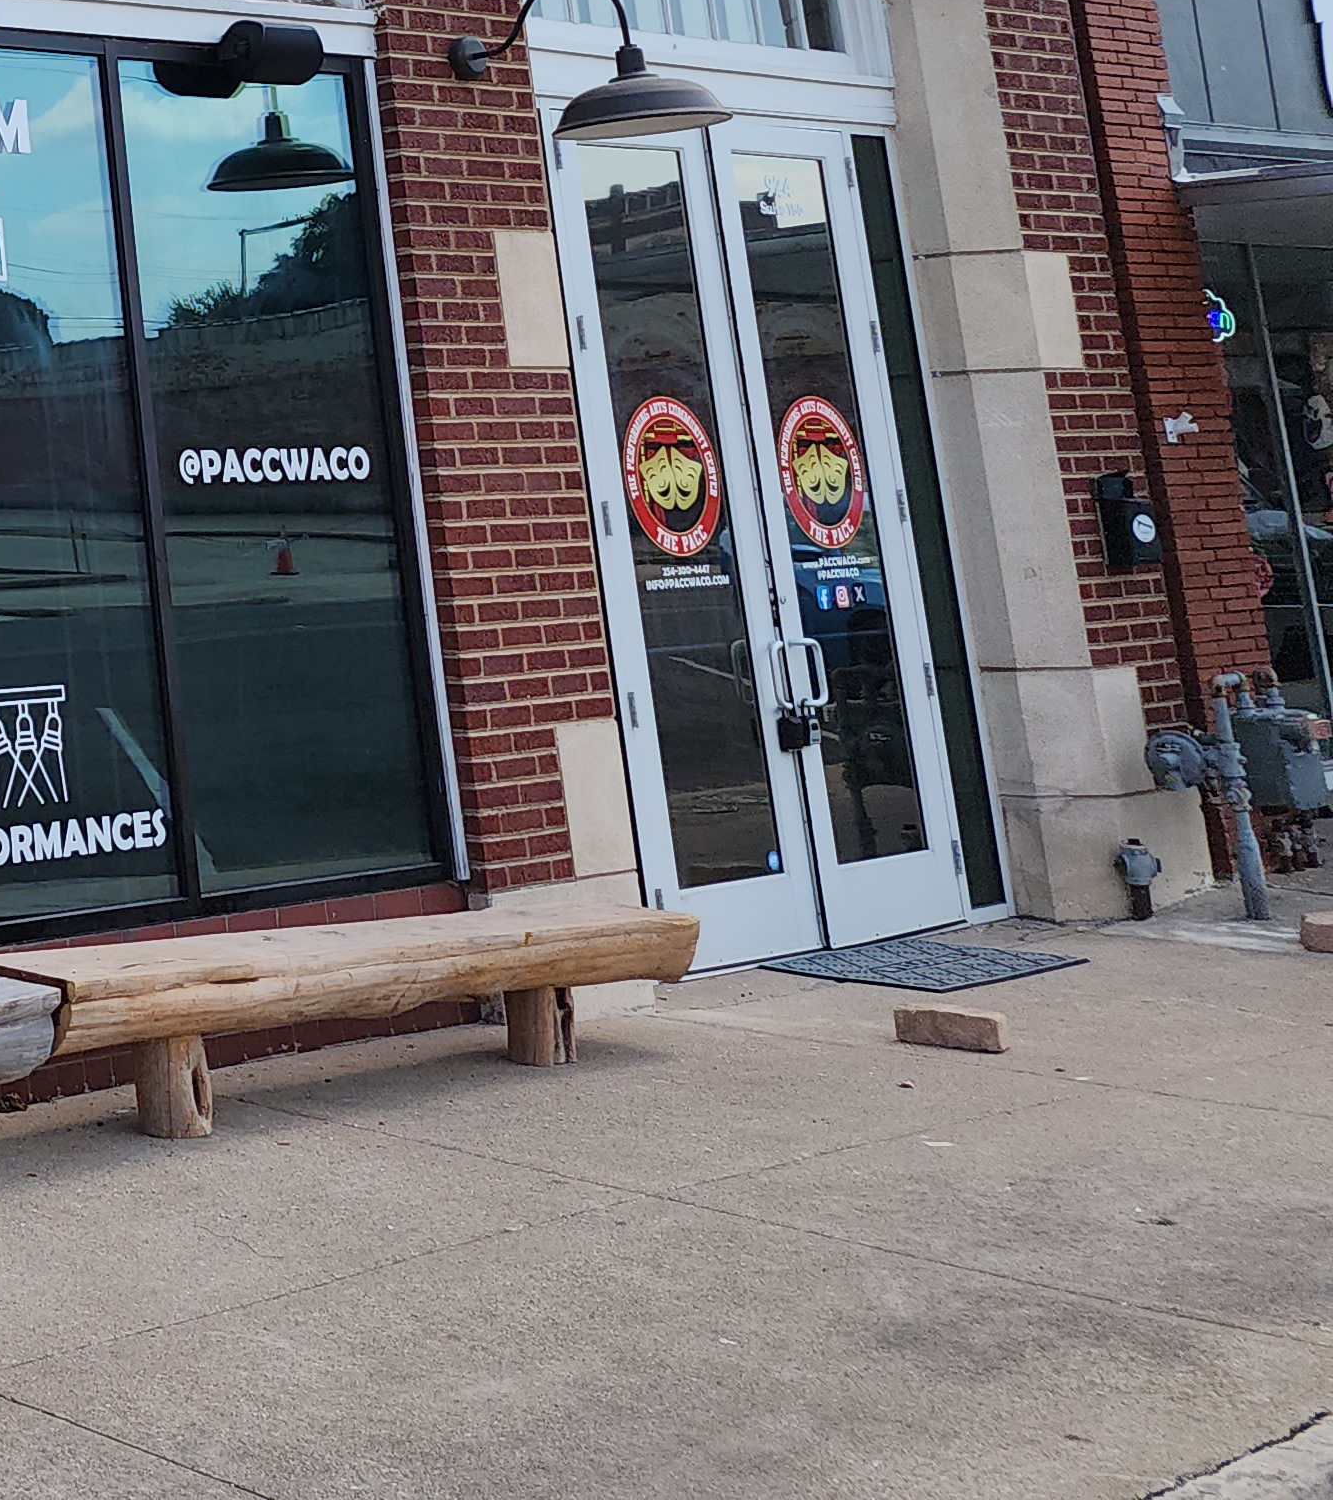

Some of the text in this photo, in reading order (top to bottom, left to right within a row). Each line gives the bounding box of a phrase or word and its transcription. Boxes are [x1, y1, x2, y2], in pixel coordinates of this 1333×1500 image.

[179, 446, 370, 485] @PACCWACO
[656, 524, 708, 552] THE PACC
[809, 518, 854, 545] THE PACC
